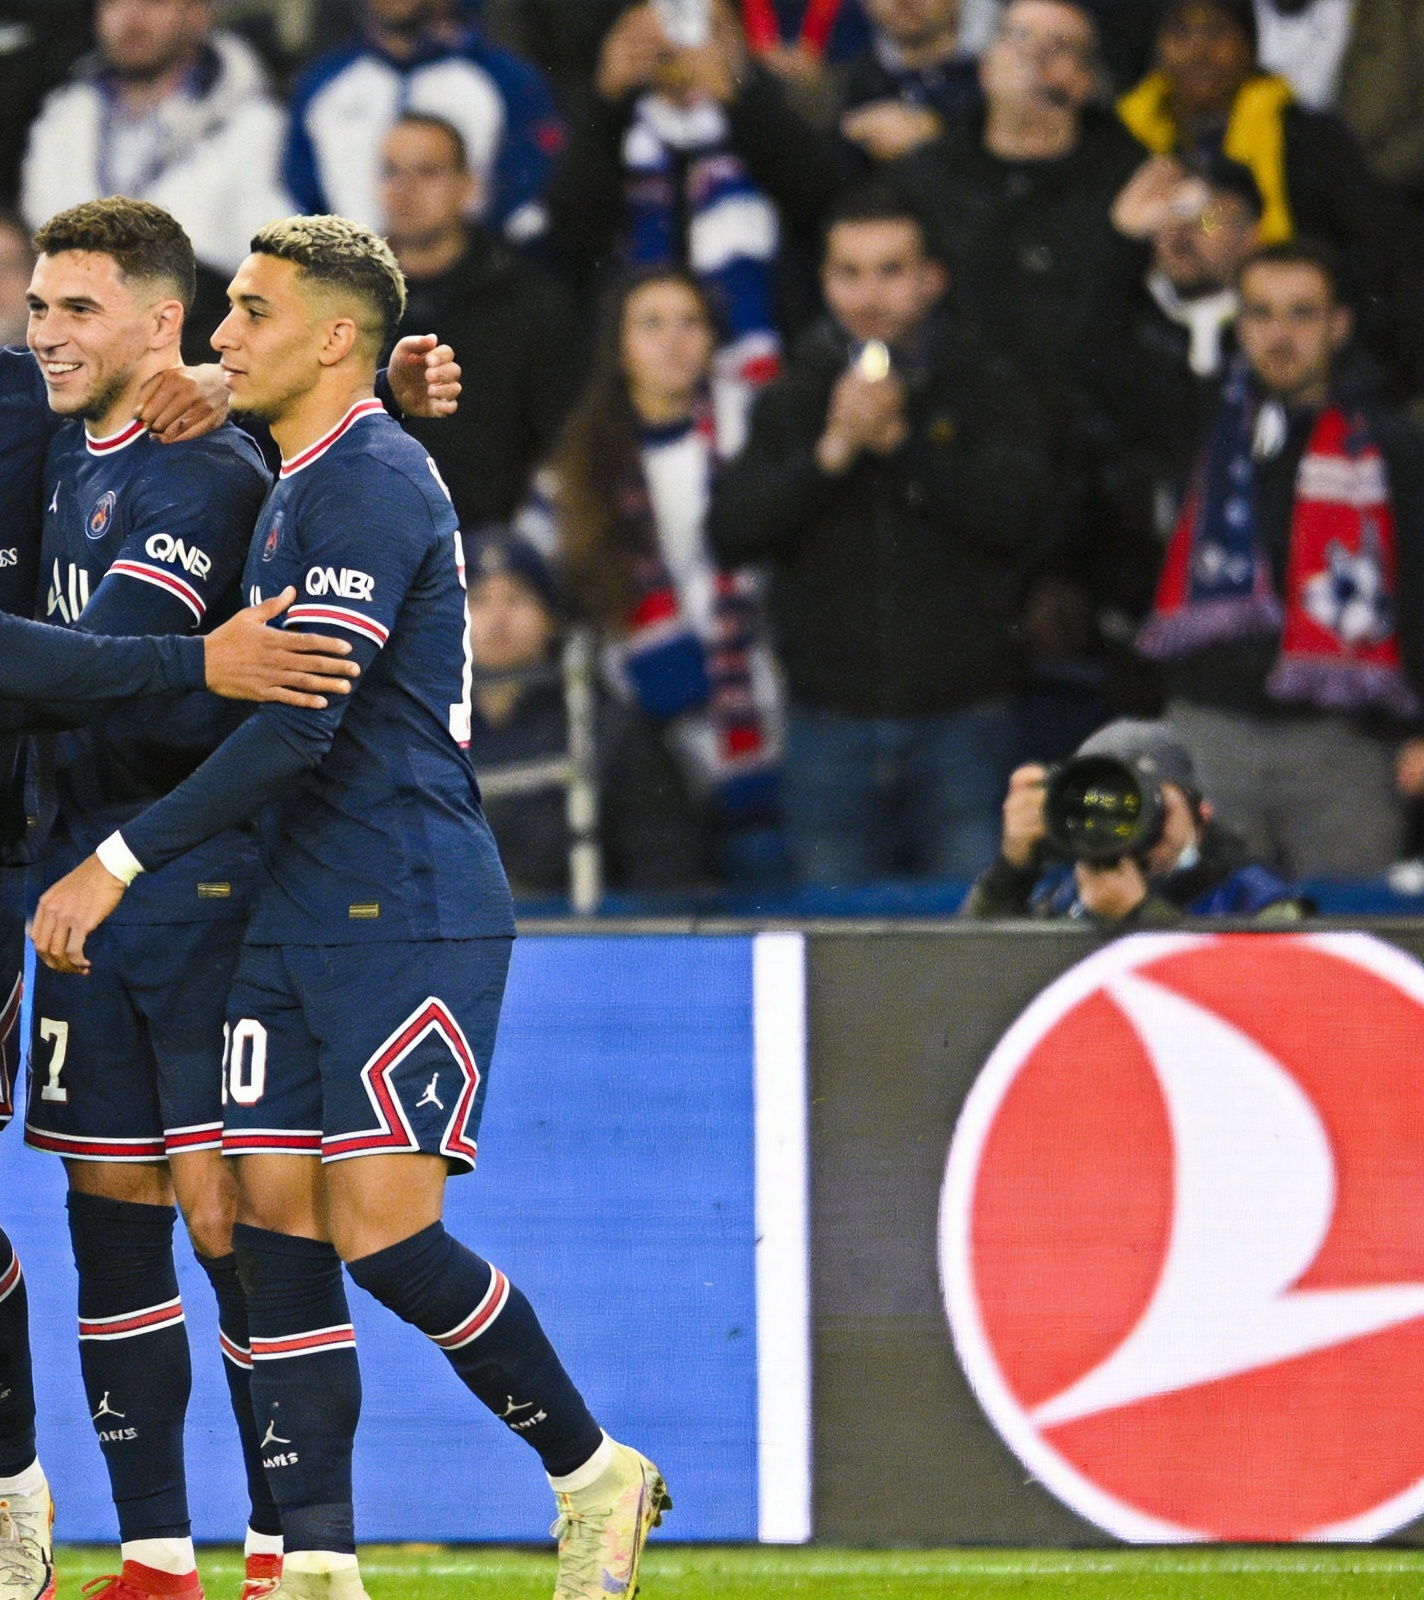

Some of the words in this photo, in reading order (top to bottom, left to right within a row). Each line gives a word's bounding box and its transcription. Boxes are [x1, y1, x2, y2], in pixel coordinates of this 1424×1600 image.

[144, 533, 212, 581] QNB
[305, 566, 375, 601] QNB
[40, 1017, 69, 1104] 7
